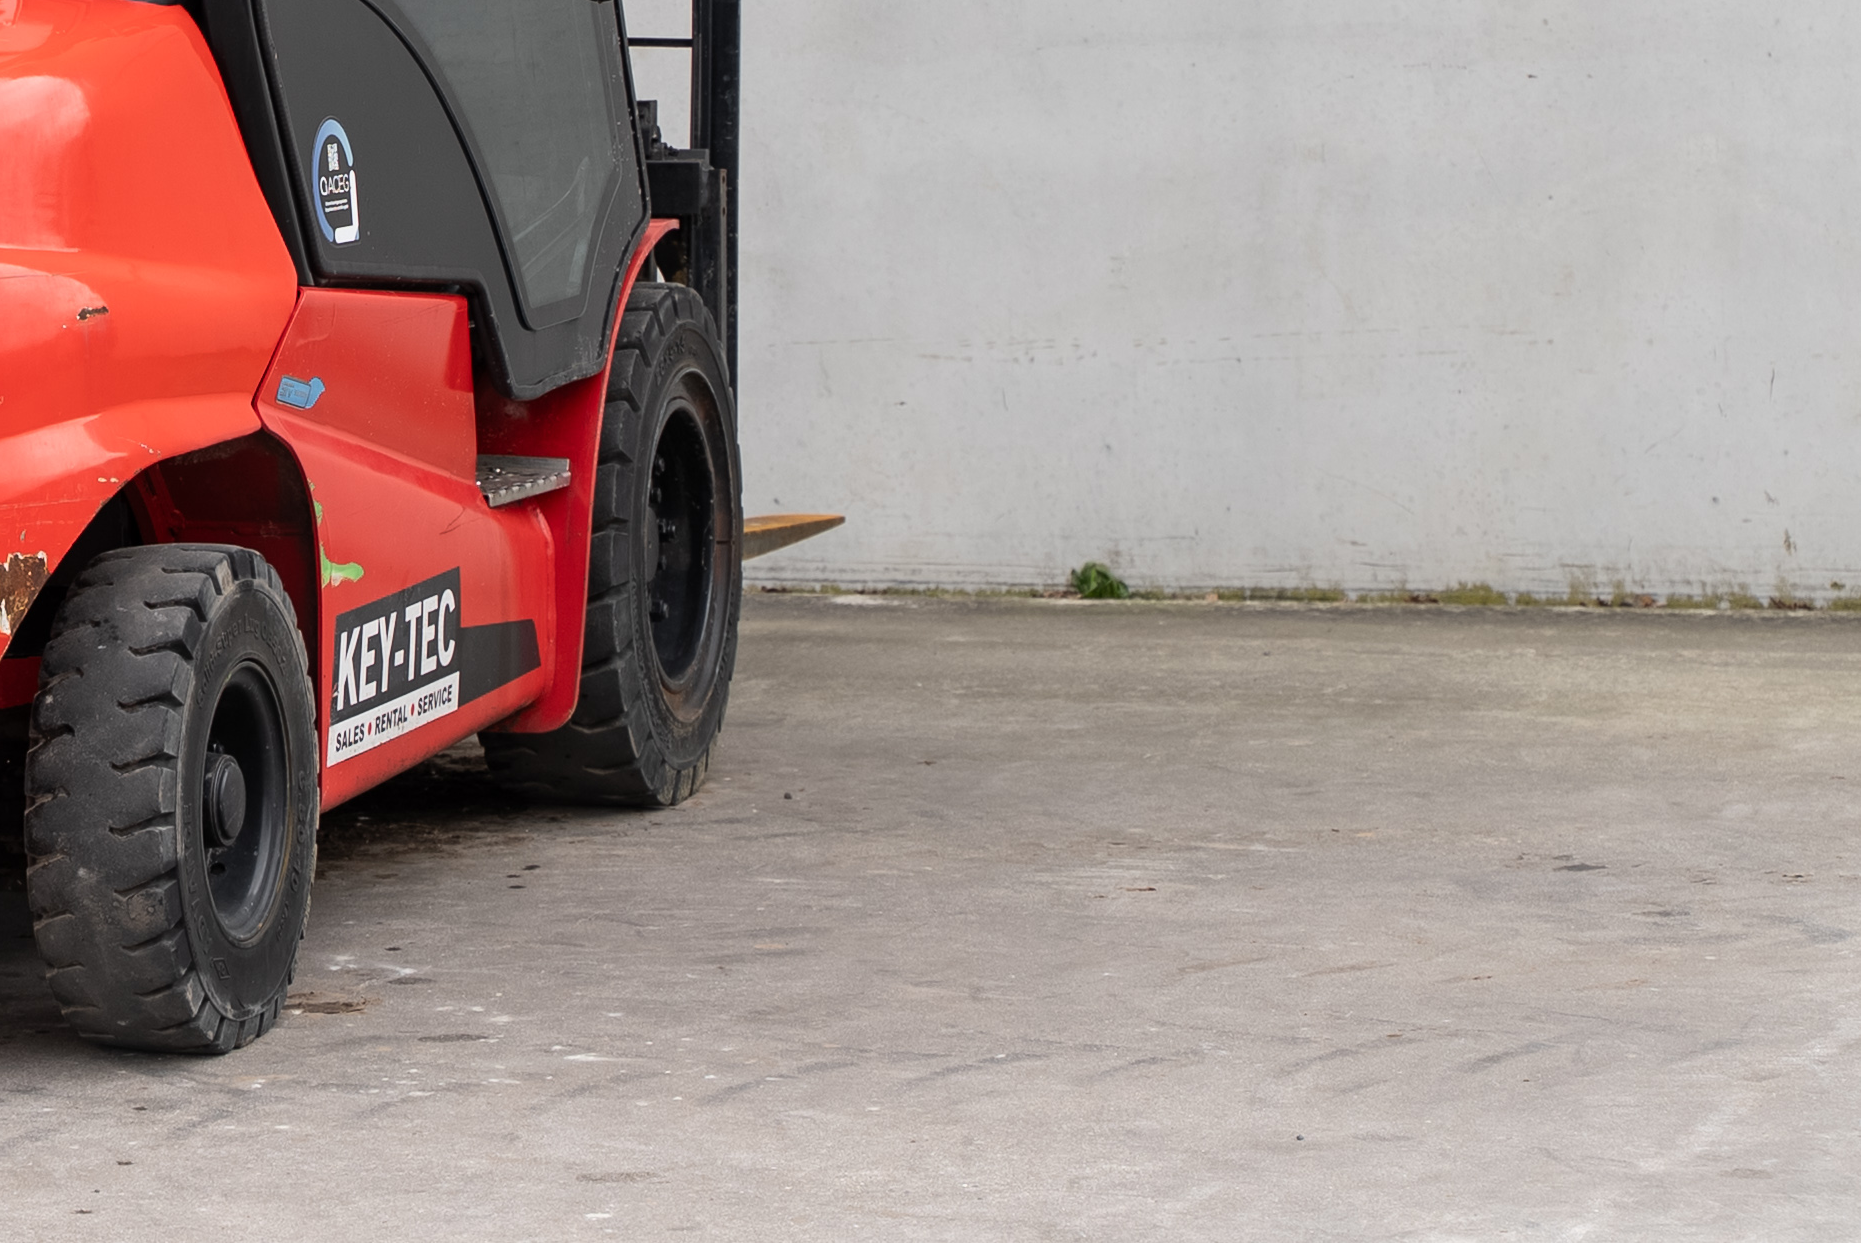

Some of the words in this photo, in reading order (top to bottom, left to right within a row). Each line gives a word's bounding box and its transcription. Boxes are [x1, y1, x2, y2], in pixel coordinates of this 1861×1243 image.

[337, 589, 456, 711] KEY-TEC
[336, 721, 365, 752] SALES
[374, 707, 408, 735] RENTAL
[417, 684, 453, 716] SERVICE
